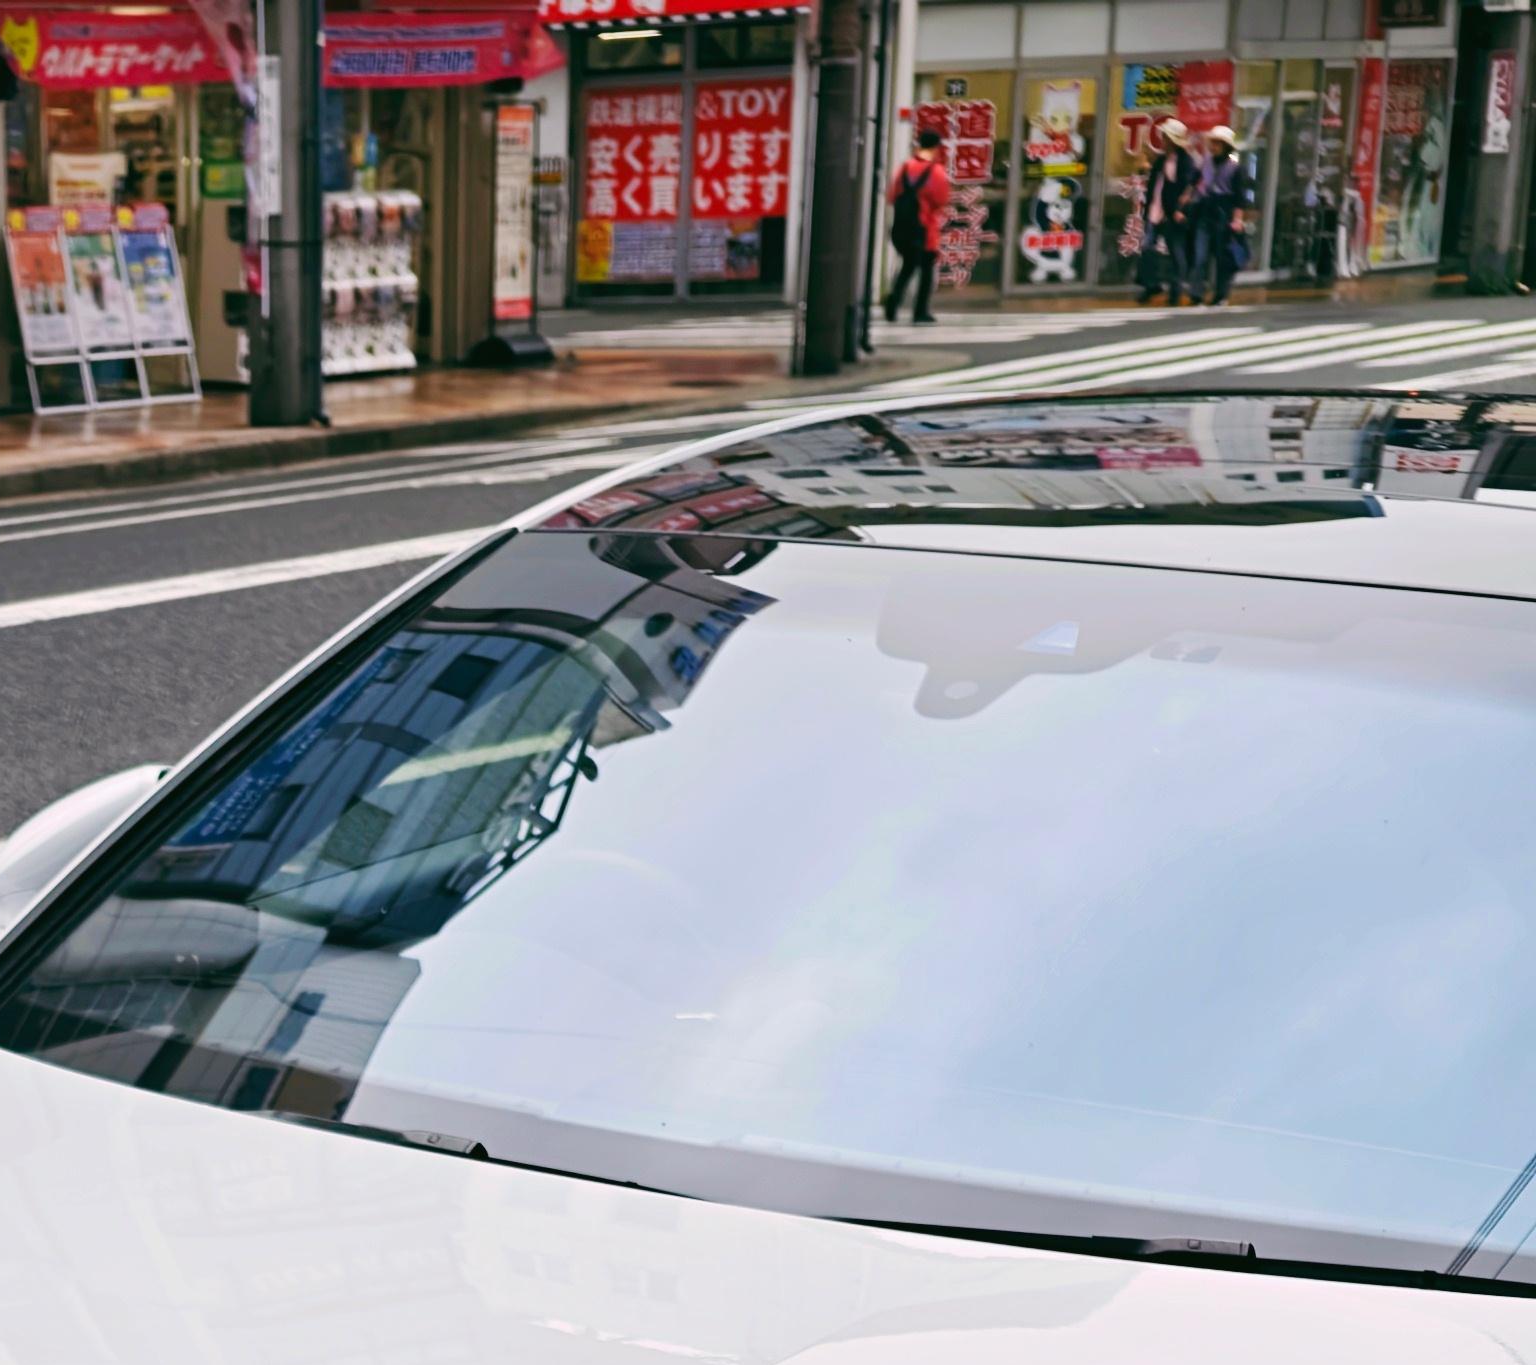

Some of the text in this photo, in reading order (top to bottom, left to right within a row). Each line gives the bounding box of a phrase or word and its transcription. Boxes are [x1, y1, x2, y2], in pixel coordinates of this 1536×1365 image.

[41, 43, 205, 78] ウルトラマーケット
[589, 127, 790, 174] 安く売ります
[587, 171, 789, 217] 高く買います
